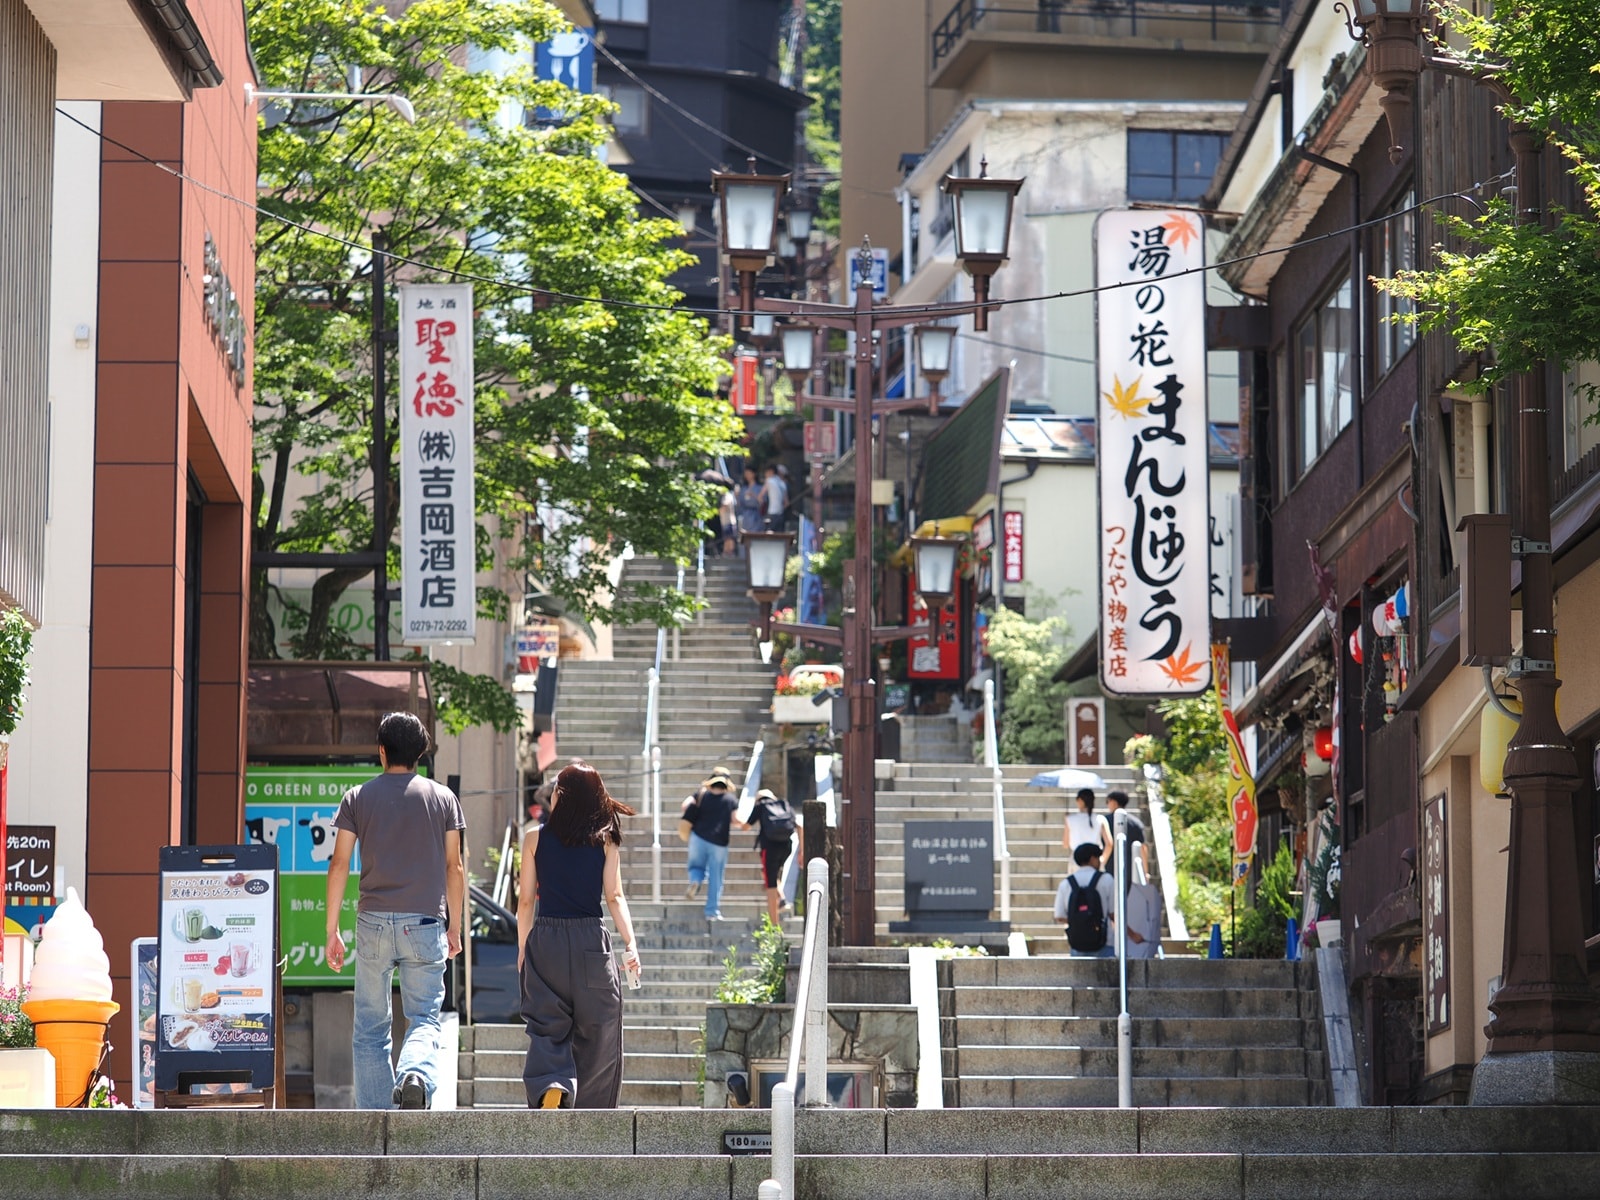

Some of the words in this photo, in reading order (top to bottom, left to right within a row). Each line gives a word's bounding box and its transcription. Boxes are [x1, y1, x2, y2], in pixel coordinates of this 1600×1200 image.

[416, 298, 457, 309] 地酒
[413, 318, 464, 417] 聖徳
[1124, 225, 1187, 661] 湯の花まんじゅう
[1105, 525, 1128, 677] つたや物産店
[410, 620, 468, 632] 0279-72-2292
[263, 783, 312, 796] GREEN
[318, 783, 352, 796] BOK
[7, 836, 50, 849] 先20m
[7, 858, 49, 879] イレ
[15, 881, 52, 893] Room)
[170, 888, 241, 899] 黒糖わらびラテ
[290, 942, 356, 967] グリン
